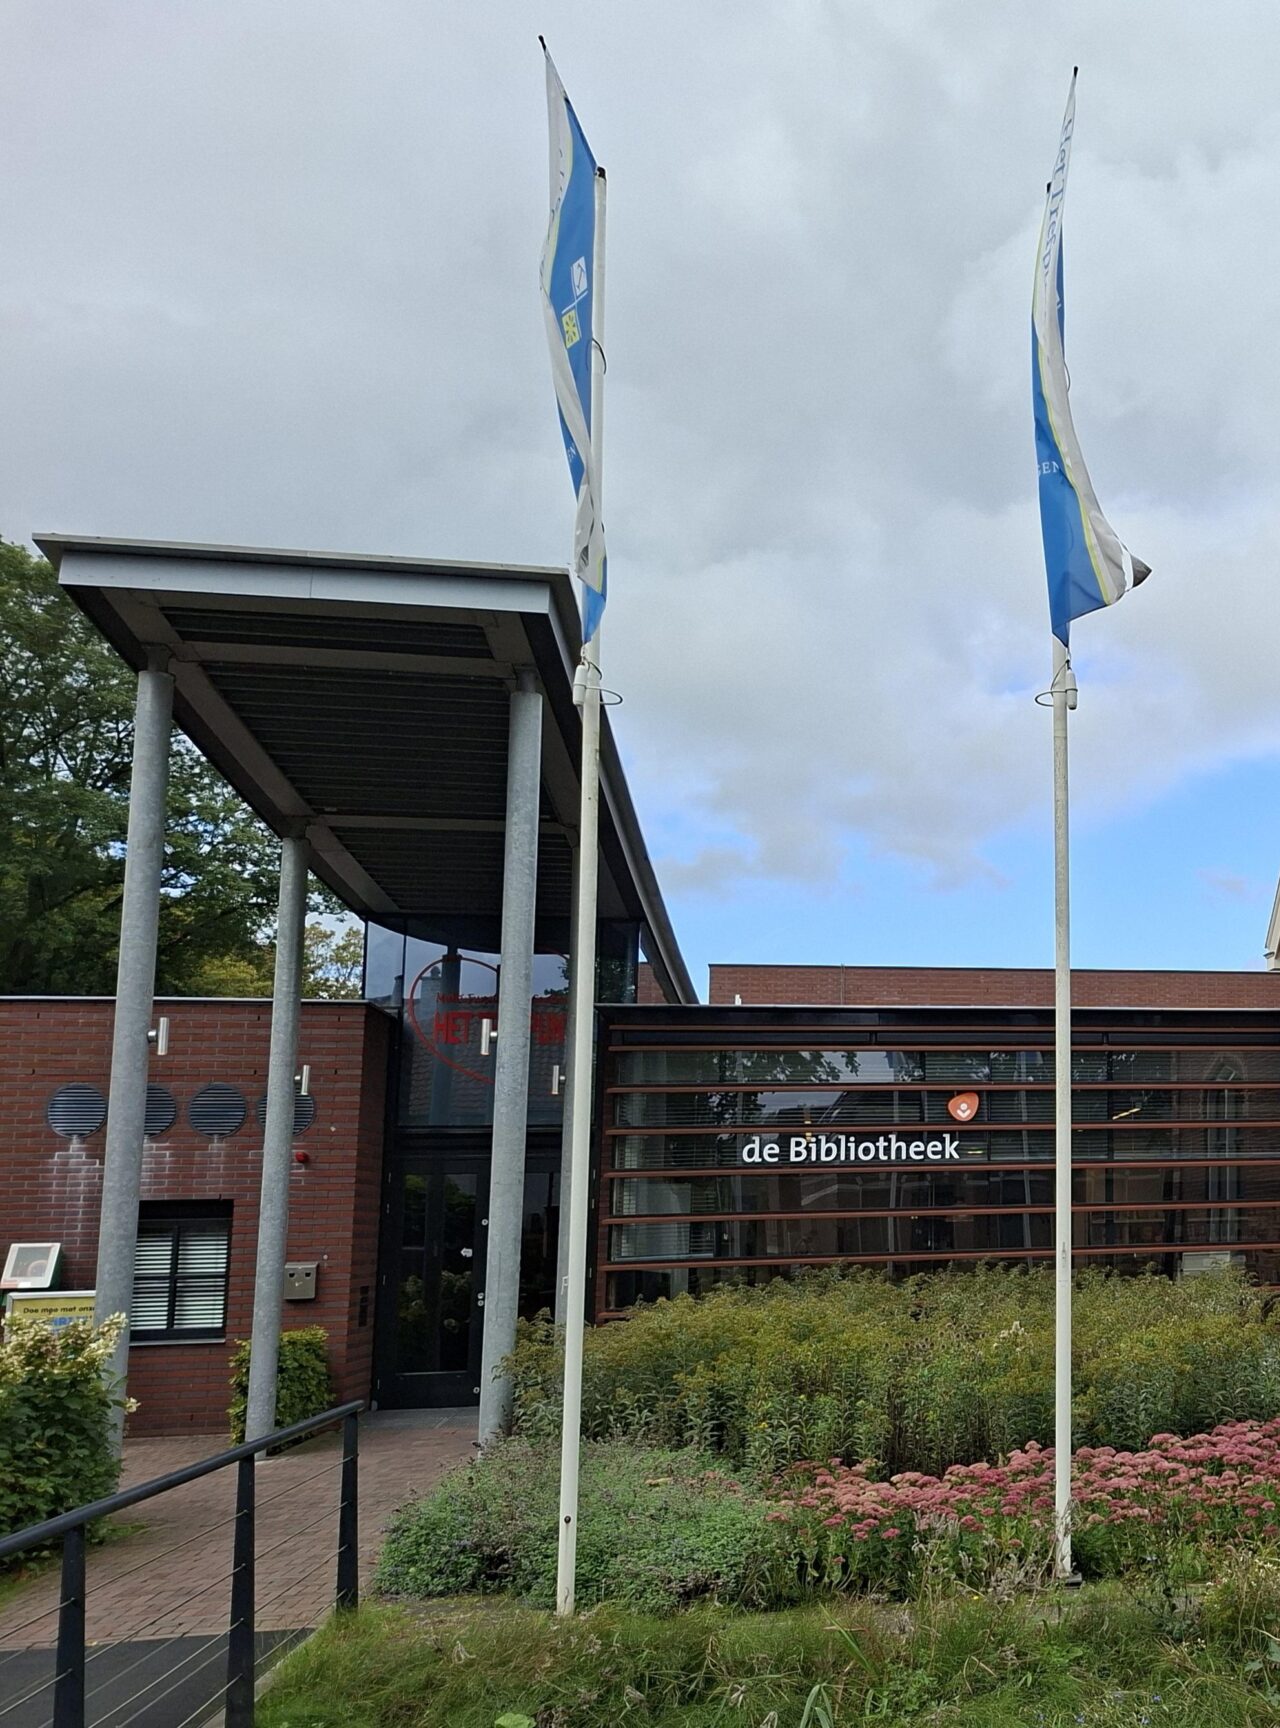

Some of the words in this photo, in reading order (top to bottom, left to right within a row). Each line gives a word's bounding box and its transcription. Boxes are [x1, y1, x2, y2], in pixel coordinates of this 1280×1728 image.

[433, 1009, 472, 1045] HET
[742, 1135, 780, 1163] de
[789, 1133, 961, 1163] Bibliotheek
